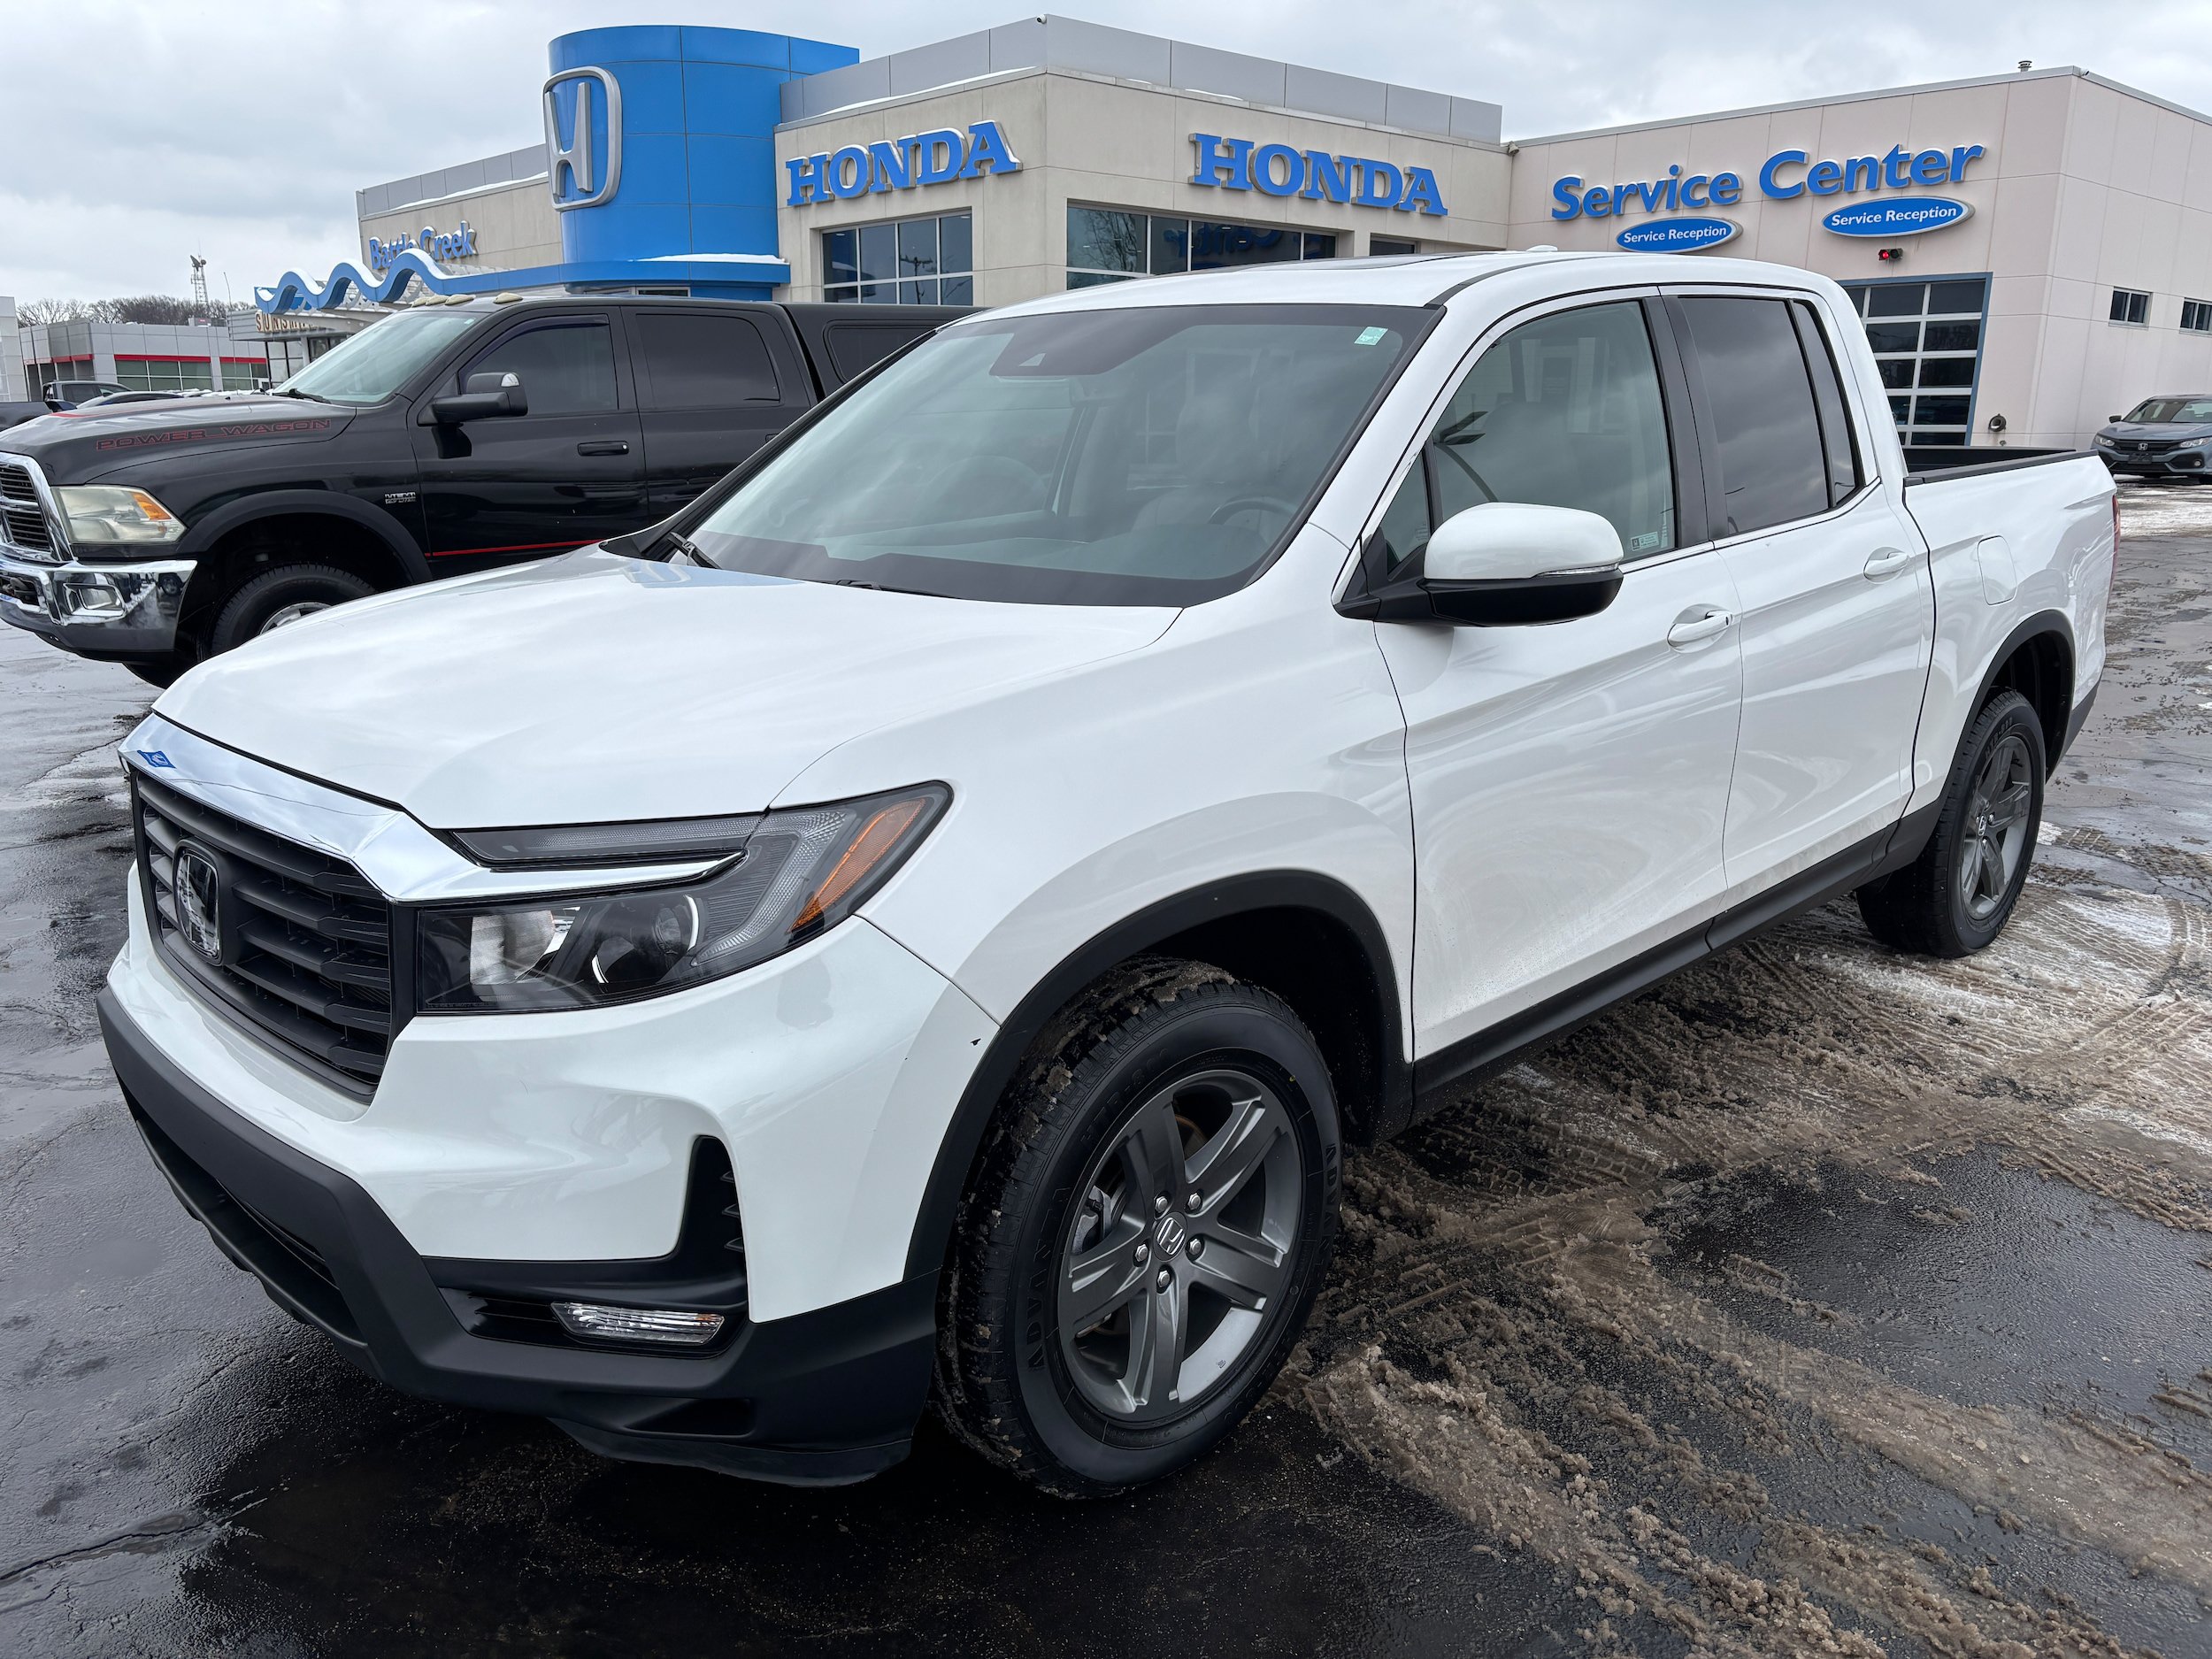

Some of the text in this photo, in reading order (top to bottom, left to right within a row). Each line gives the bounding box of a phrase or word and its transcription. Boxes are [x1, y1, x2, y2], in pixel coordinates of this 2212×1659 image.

[786, 119, 1023, 206] HONDA
[1188, 133, 1448, 216] HONDA
[1552, 143, 1986, 220] Service Center
[1624, 226, 1726, 243] Service Reception
[1832, 206, 1956, 227] Service Reception
[420, 220, 478, 260] Creek
[96, 419, 332, 450] POWER WAGON
